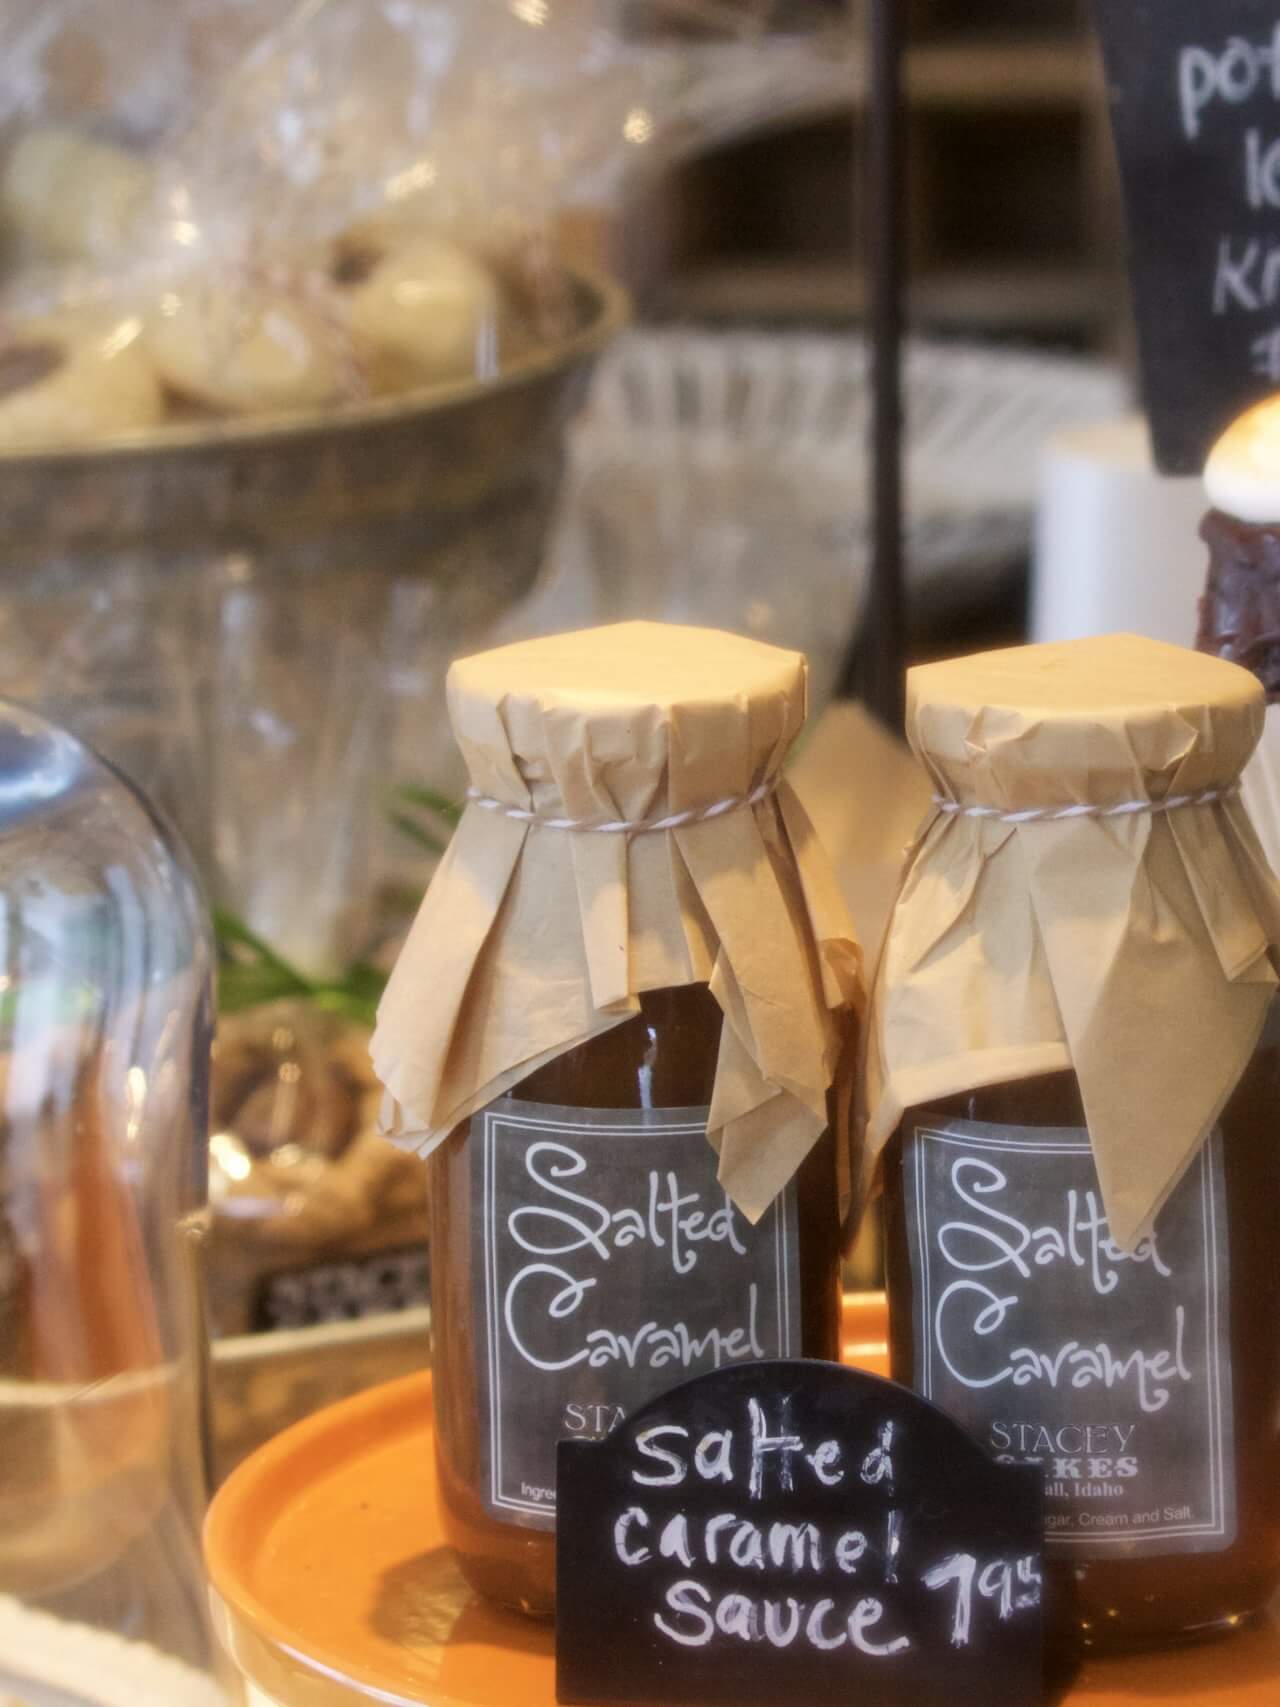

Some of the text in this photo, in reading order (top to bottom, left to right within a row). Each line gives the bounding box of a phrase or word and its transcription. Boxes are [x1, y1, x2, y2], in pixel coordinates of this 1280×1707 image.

[508, 1140, 747, 1274] Salted
[504, 1262, 765, 1370] Caramel
[935, 1279, 1192, 1413] Caramel
[564, 1402, 626, 1434] STA
[990, 1420, 1136, 1454] STACEY
[994, 1454, 1139, 1480] KES
[1044, 1481, 1125, 1498] all, Idaho
[1078, 1512, 1129, 1527] Cream
[1131, 1508, 1160, 1523] and
